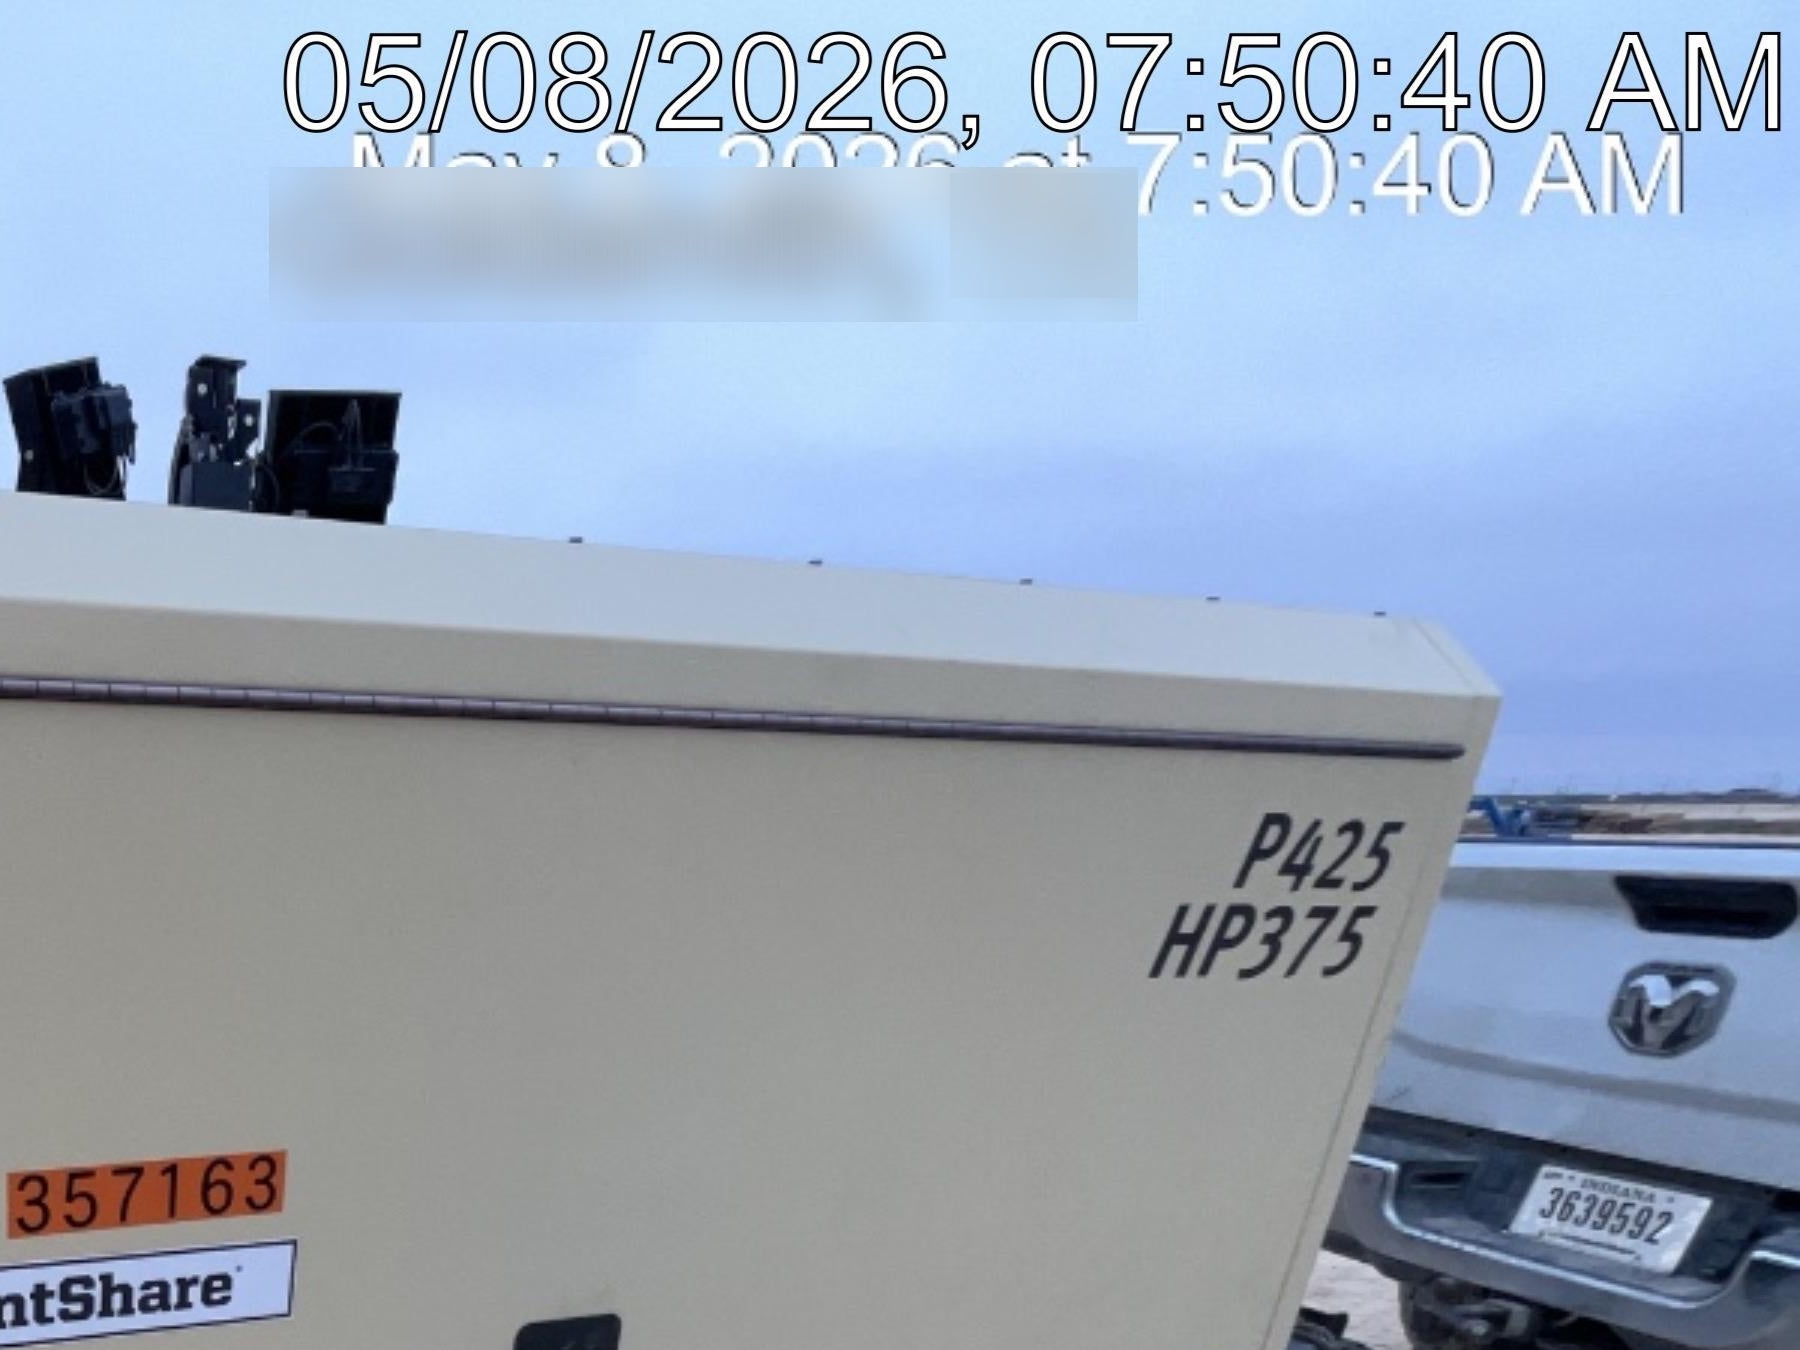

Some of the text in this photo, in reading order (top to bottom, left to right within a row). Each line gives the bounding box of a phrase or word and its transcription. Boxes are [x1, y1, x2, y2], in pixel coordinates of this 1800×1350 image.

[1232, 812, 1406, 892] P425
[1148, 903, 1379, 980] HP375
[14, 1154, 280, 1235] 357163
[1538, 1187, 1675, 1246] 3639592
[1580, 1179, 1657, 1204] INDIANA
